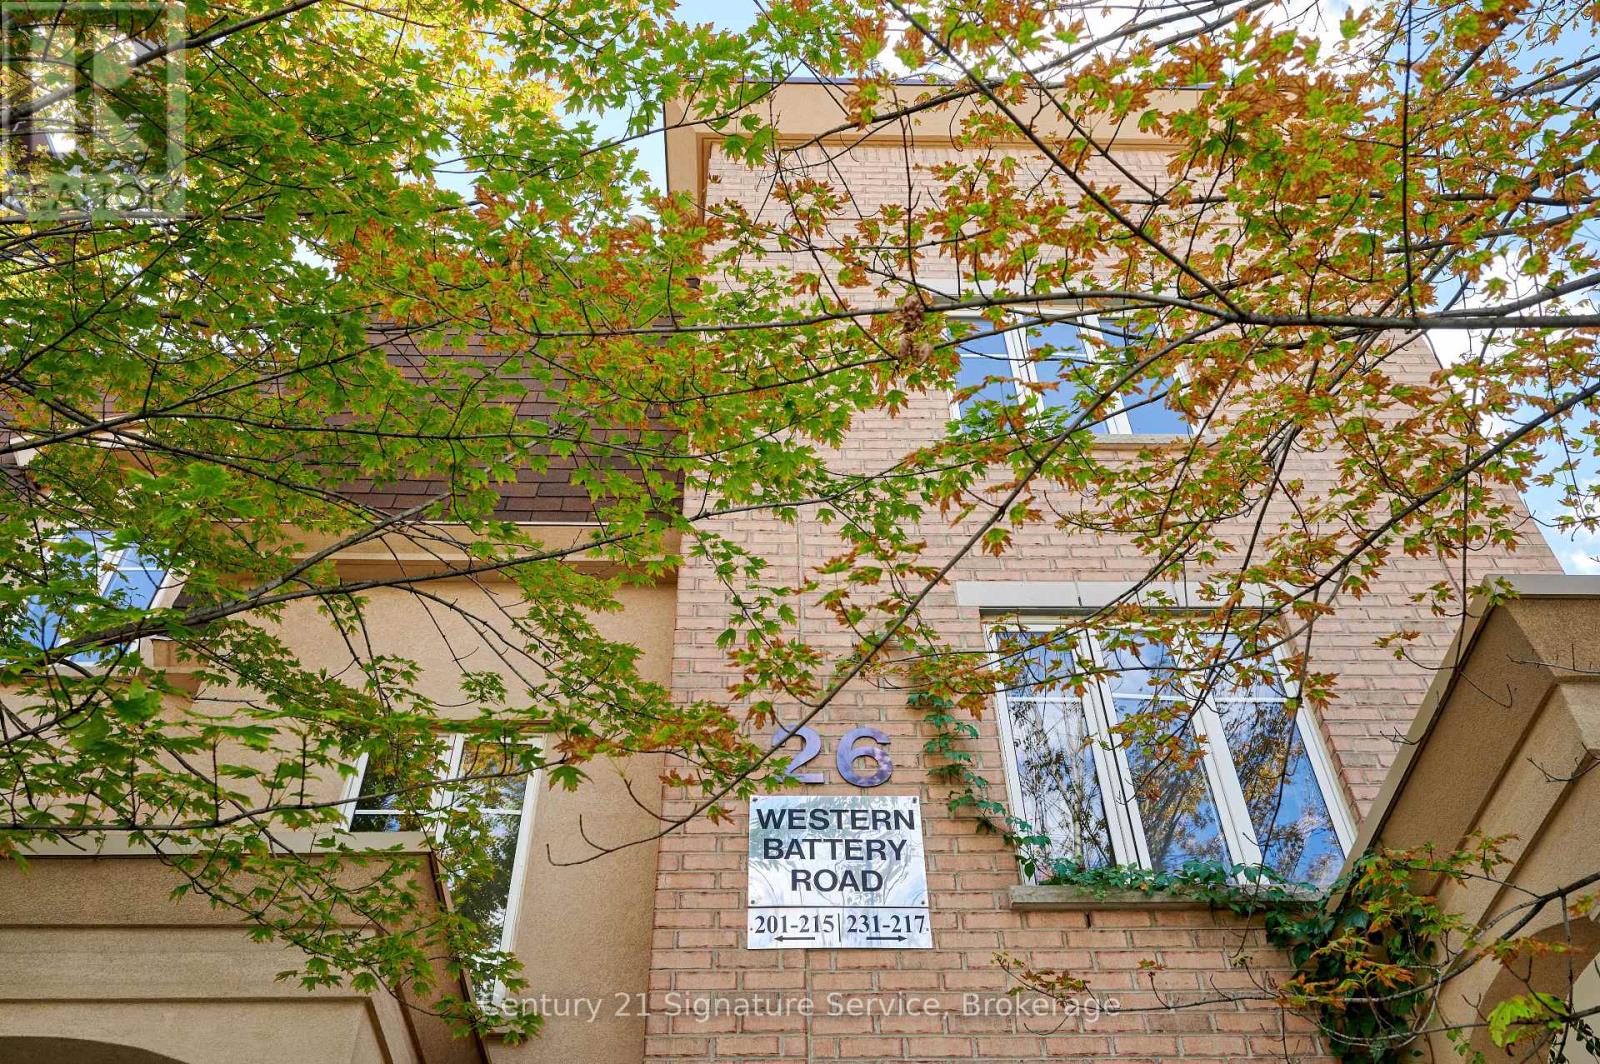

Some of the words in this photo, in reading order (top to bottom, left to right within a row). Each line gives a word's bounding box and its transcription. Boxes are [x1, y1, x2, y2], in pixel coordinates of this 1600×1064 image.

[772, 724, 893, 787] 26
[757, 809, 914, 830] WESTERN
[763, 838, 907, 861] BATTERY
[791, 869, 883, 892] ROAD
[755, 914, 834, 933] 201-215
[846, 914, 925, 933] 231-217
